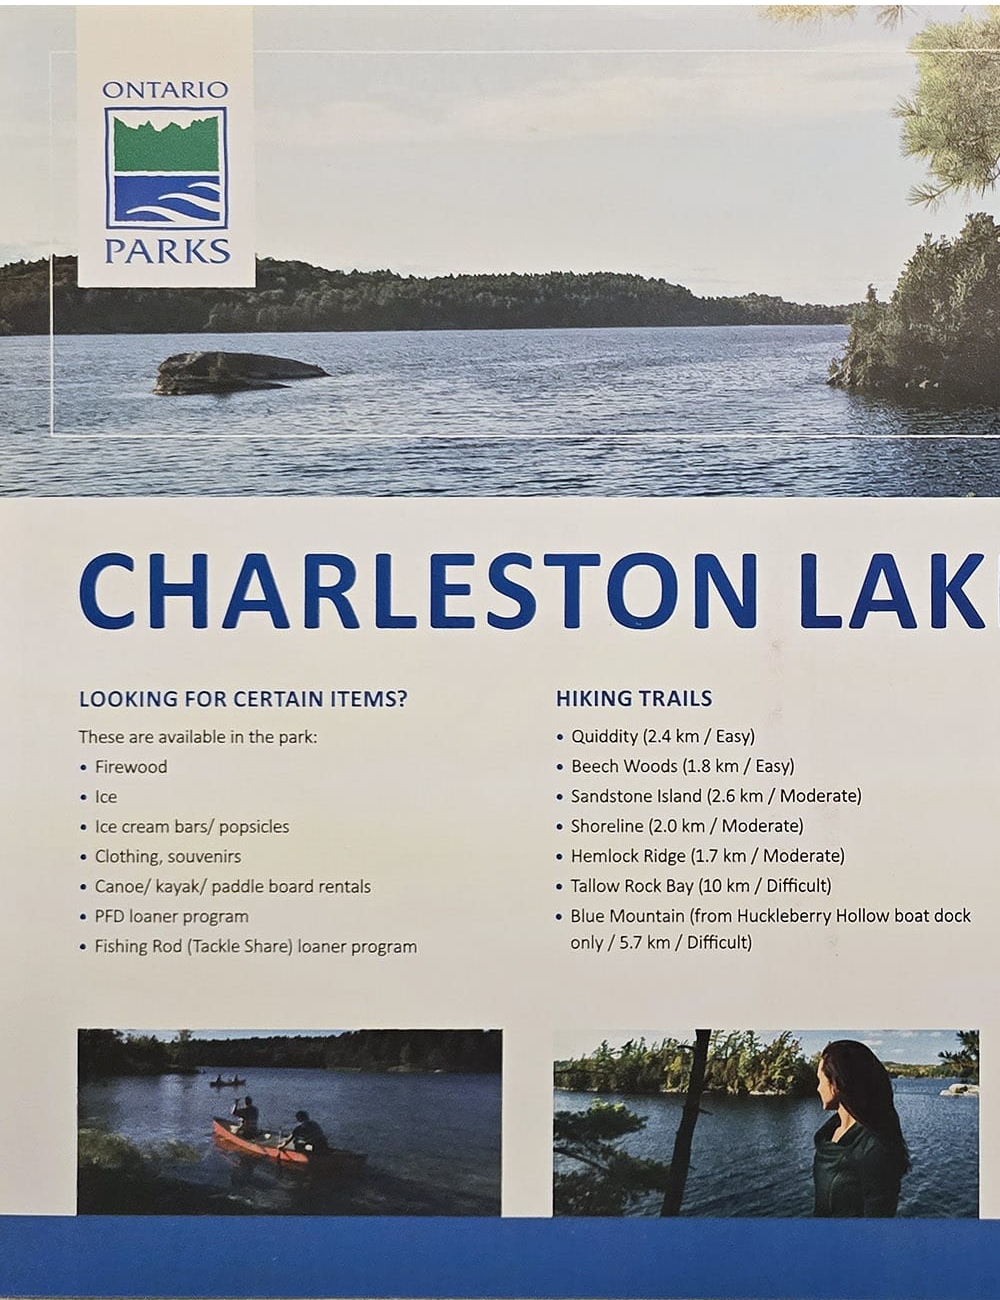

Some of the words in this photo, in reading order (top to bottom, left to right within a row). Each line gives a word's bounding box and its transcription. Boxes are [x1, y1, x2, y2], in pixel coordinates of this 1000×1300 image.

[103, 81, 228, 98] ONTARIO
[106, 239, 230, 264] PARKS
[79, 552, 757, 630] CHARLESTON
[80, 691, 177, 707] LOOKING
[186, 691, 227, 707] FOR
[234, 691, 323, 707] CERTAIN
[331, 690, 407, 707] ITEMS?
[557, 690, 632, 707] HIKING
[638, 690, 712, 707] TRAILS
[572, 729, 638, 746] Quiddity
[643, 728, 671, 746] (2.4
[676, 728, 699, 743] km
[717, 728, 755, 746] Easy)
[96, 759, 167, 774] Firewood
